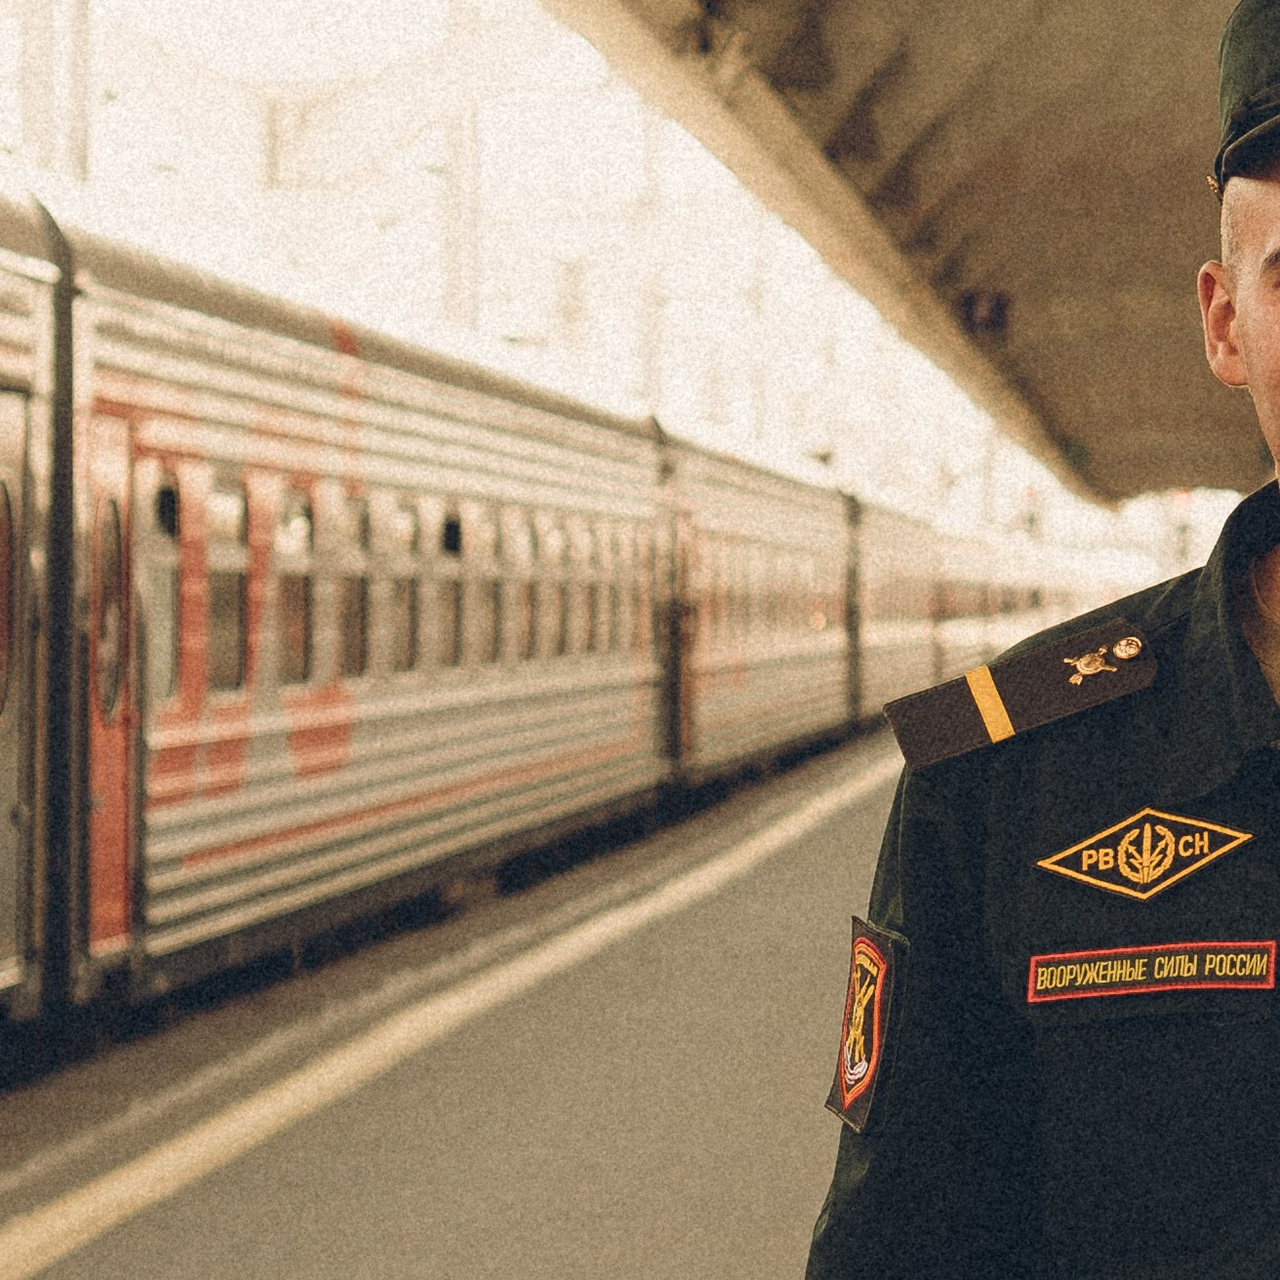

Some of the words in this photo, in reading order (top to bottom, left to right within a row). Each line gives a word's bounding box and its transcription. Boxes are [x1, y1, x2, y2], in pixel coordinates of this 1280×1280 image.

[1081, 848, 1115, 871] РВ
[1178, 831, 1210, 858] СН
[1036, 958, 1148, 990] ВООРУЖЕННЫЕ
[1153, 954, 1198, 980] СИЛЫ
[1204, 953, 1268, 977] РОССИИ
